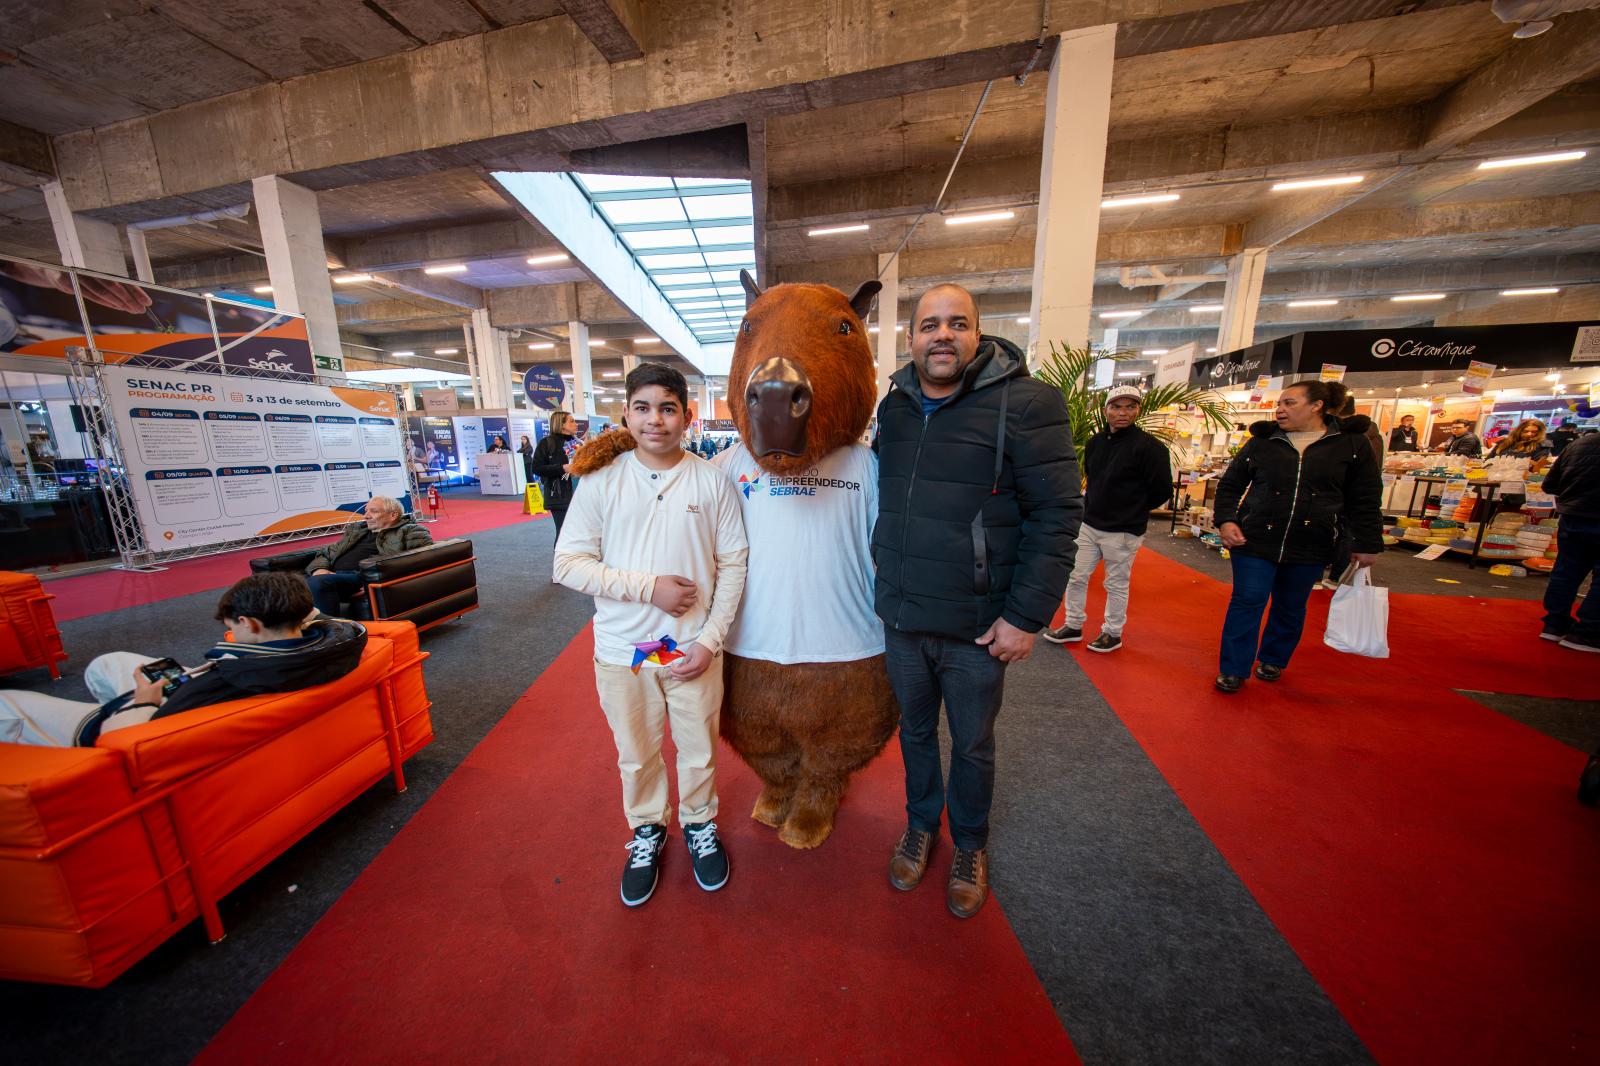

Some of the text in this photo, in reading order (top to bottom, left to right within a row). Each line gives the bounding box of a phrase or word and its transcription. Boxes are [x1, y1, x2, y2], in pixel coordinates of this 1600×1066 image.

[1398, 340, 1476, 365] Céramique
[248, 357, 294, 372] Senac
[126, 378, 213, 394] SENAC PR
[128, 390, 216, 402] PROGRAMAÇÃO
[246, 394, 254, 403] 3
[265, 396, 277, 404] 13
[279, 397, 293, 405] de
[295, 398, 342, 408] setembro
[769, 477, 861, 491] EMPREENDEDOR
[769, 486, 817, 496] SEBRAE
